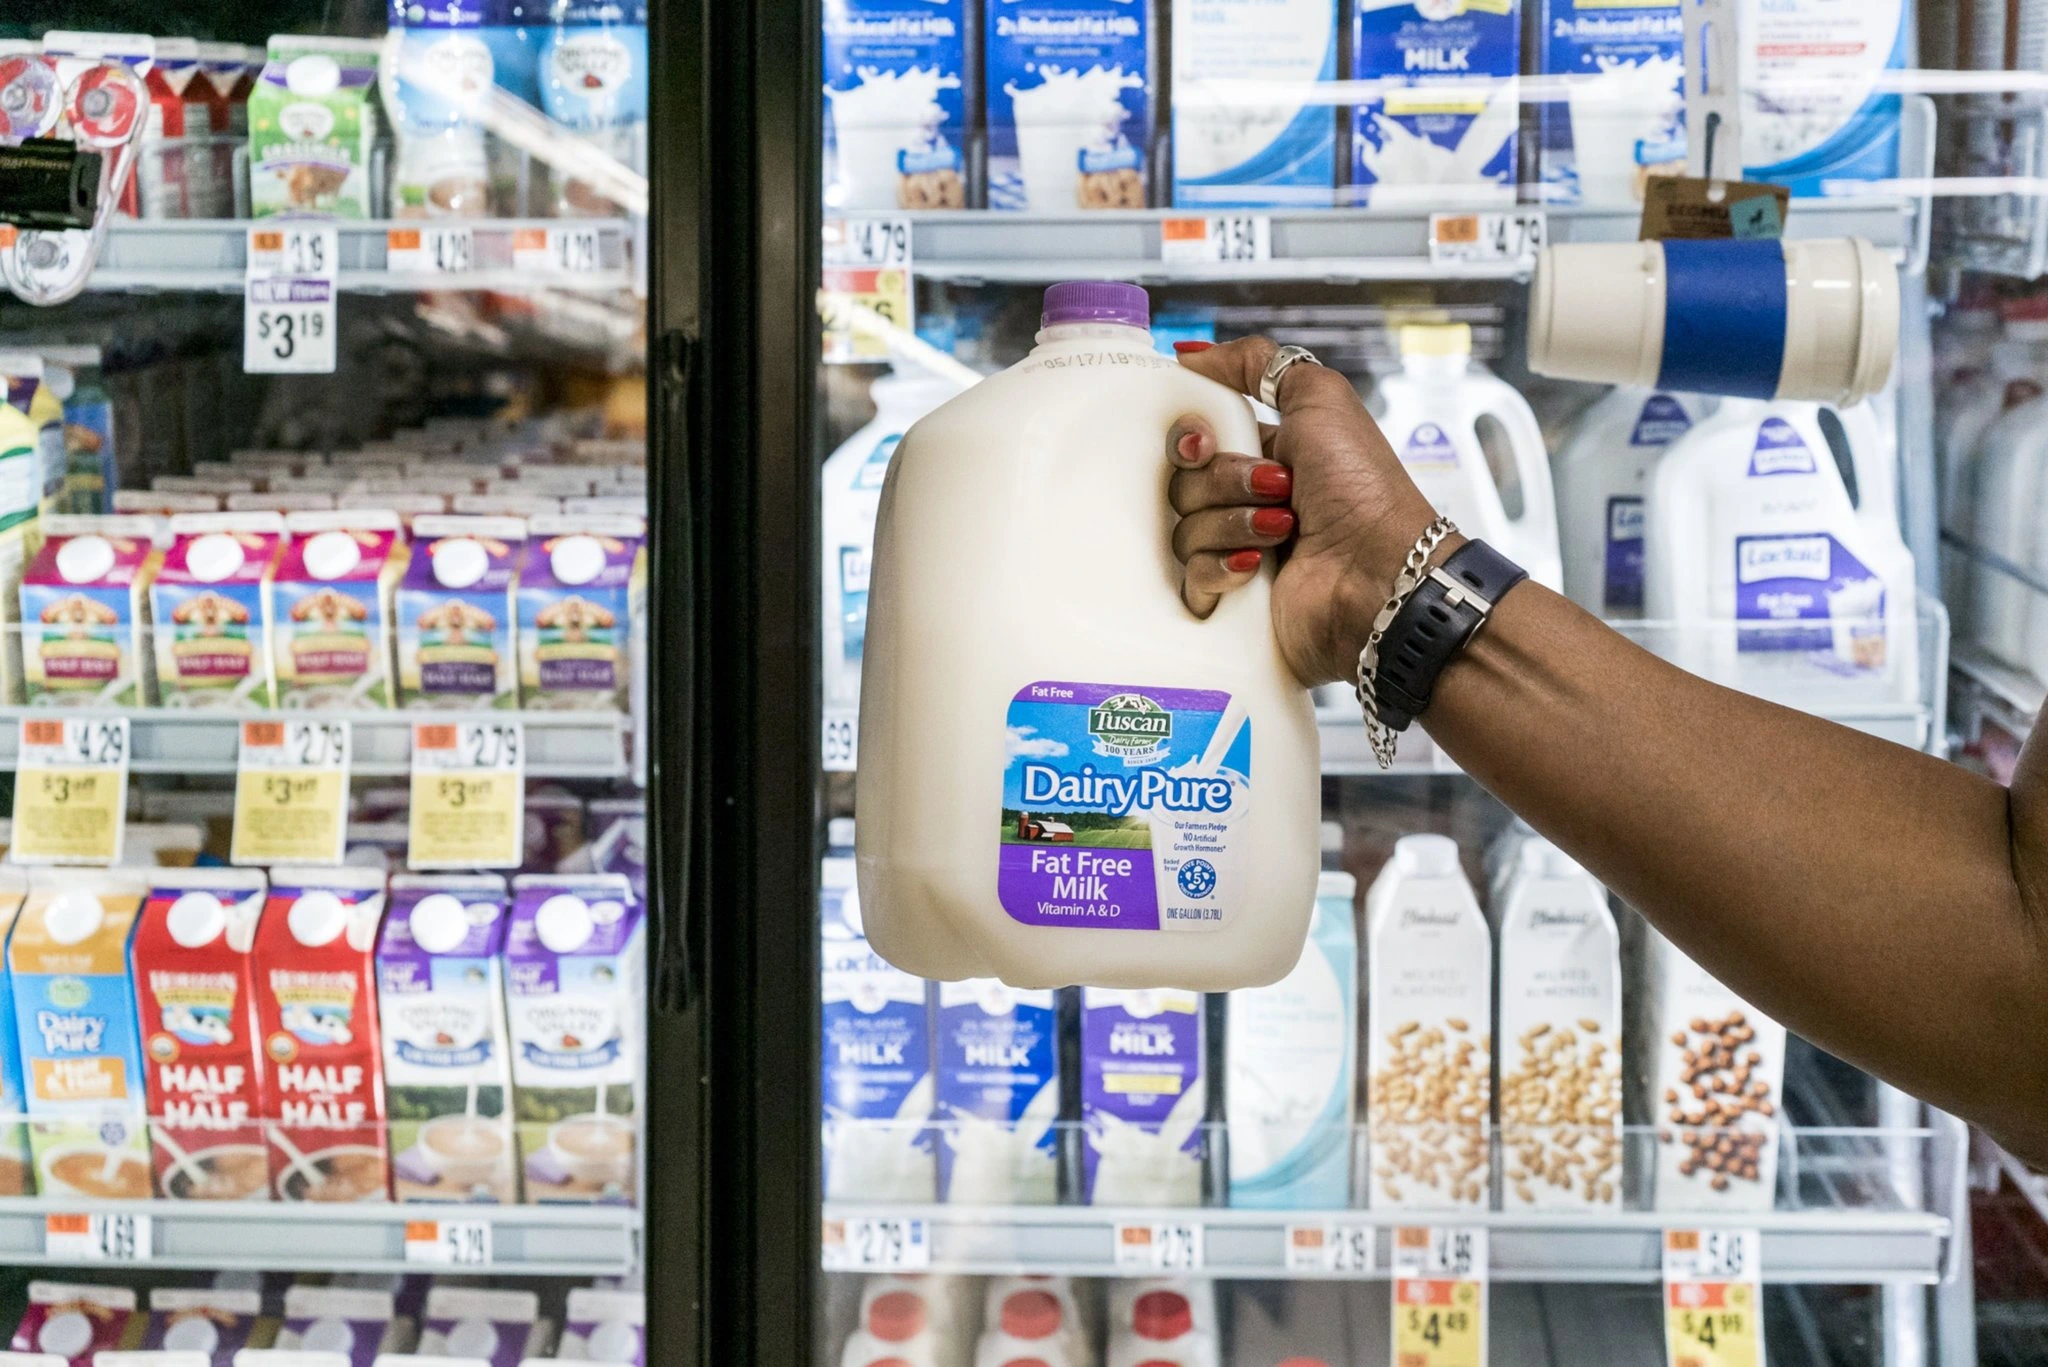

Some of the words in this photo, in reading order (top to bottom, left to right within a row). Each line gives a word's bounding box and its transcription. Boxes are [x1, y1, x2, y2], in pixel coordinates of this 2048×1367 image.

[1404, 48, 1469, 71] MILK
[1032, 685, 1048, 697] Fat
[1050, 687, 1074, 699] Free
[1094, 711, 1167, 732] Tuscan
[1105, 744, 1120, 754] 100
[1122, 745, 1155, 756] YEARS
[1174, 821, 1185, 830] Our
[1185, 821, 1208, 831] Farmers
[1208, 822, 1228, 833] Pledge
[1183, 832, 1193, 842] NO
[1193, 833, 1217, 843] Artificial
[1173, 843, 1194, 852] Growth
[1032, 850, 1074, 874] Fat
[1077, 852, 1132, 877] Free
[1052, 875, 1109, 901] Milk
[1037, 901, 1085, 917] Vitamin
[1086, 902, 1096, 916] A
[1097, 903, 1108, 917] &
[1109, 904, 1121, 917] D
[1166, 907, 1178, 919] ONE
[1179, 908, 1202, 919] GALLON
[838, 1042, 905, 1065] MILK
[964, 1043, 1031, 1066] MILK
[1109, 1031, 1176, 1055] MILK
[159, 1064, 245, 1093] HALF
[277, 1064, 363, 1093] HALF
[163, 1100, 250, 1131] HALF
[281, 1100, 366, 1130] HALF
